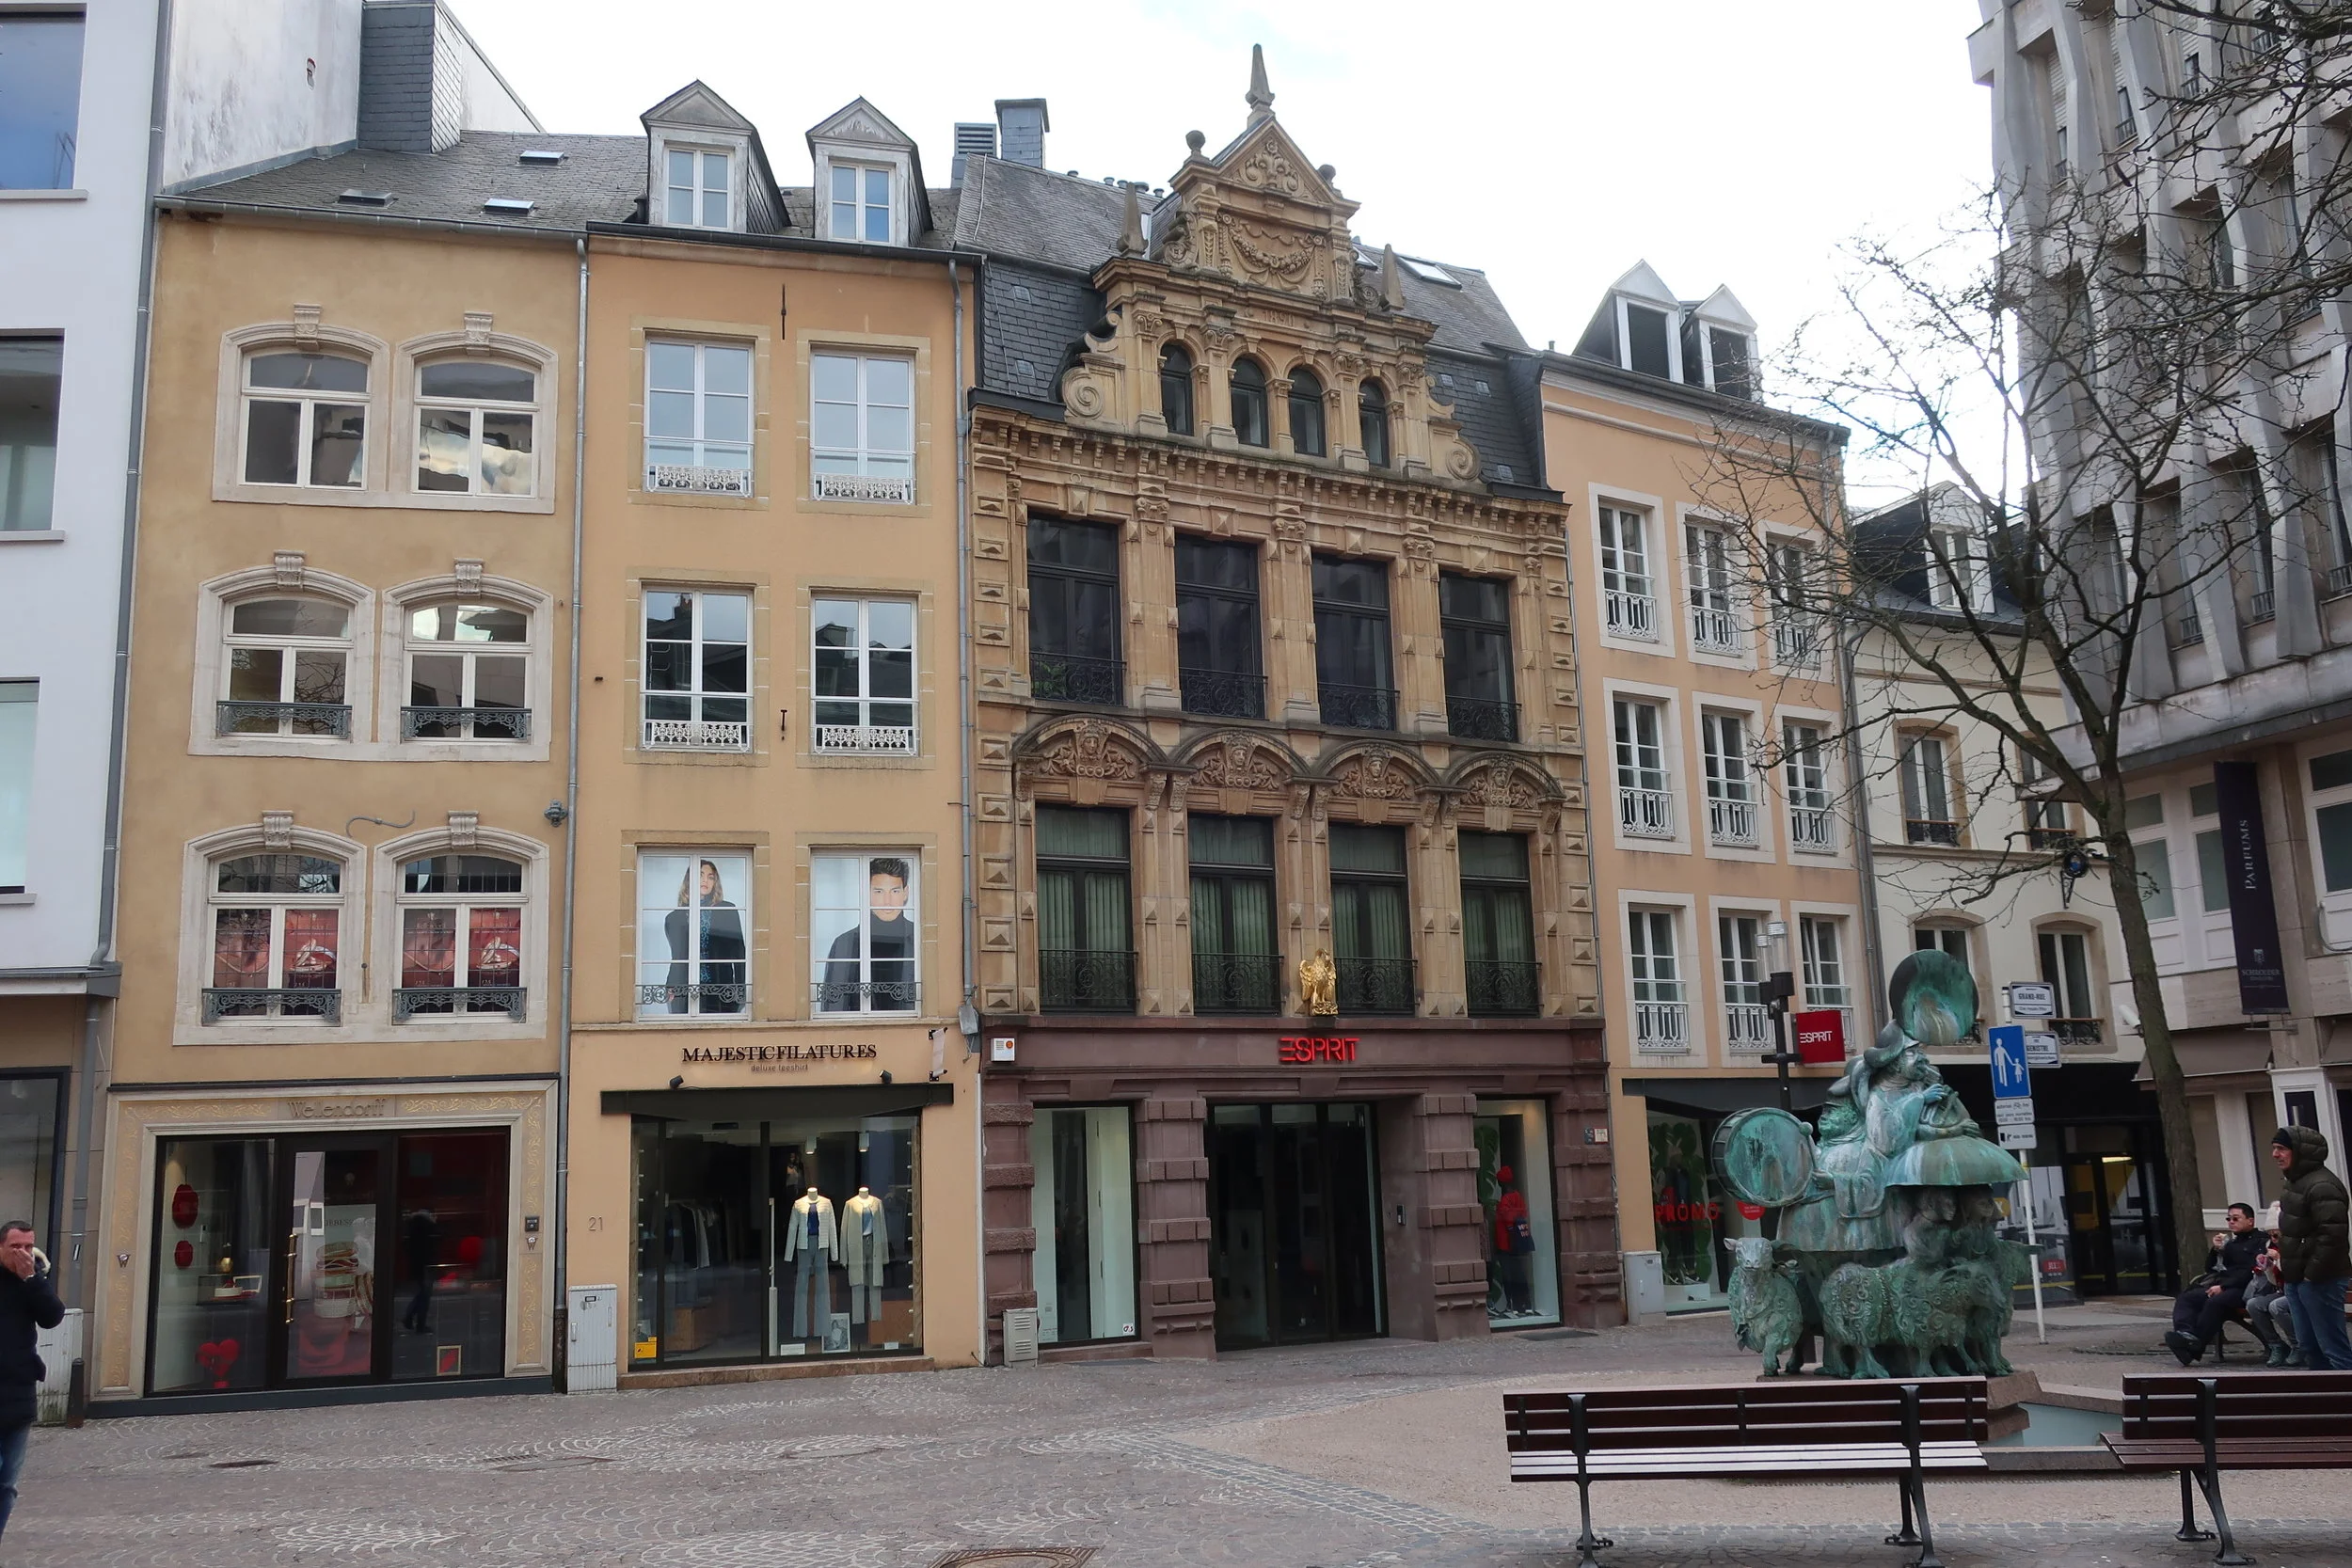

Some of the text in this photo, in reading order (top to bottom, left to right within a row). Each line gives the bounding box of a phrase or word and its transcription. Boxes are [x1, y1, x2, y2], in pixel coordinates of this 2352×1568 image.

[2239, 820, 2256, 889] PARFUMS
[1799, 1030, 1833, 1043] ESPRIT
[1279, 1037, 1360, 1061] ESPRIT
[751, 1064, 776, 1072] deluxe
[287, 1098, 386, 1118] Wellendorff
[1655, 1203, 1719, 1222] PROMO
[588, 1216, 603, 1231] 21
